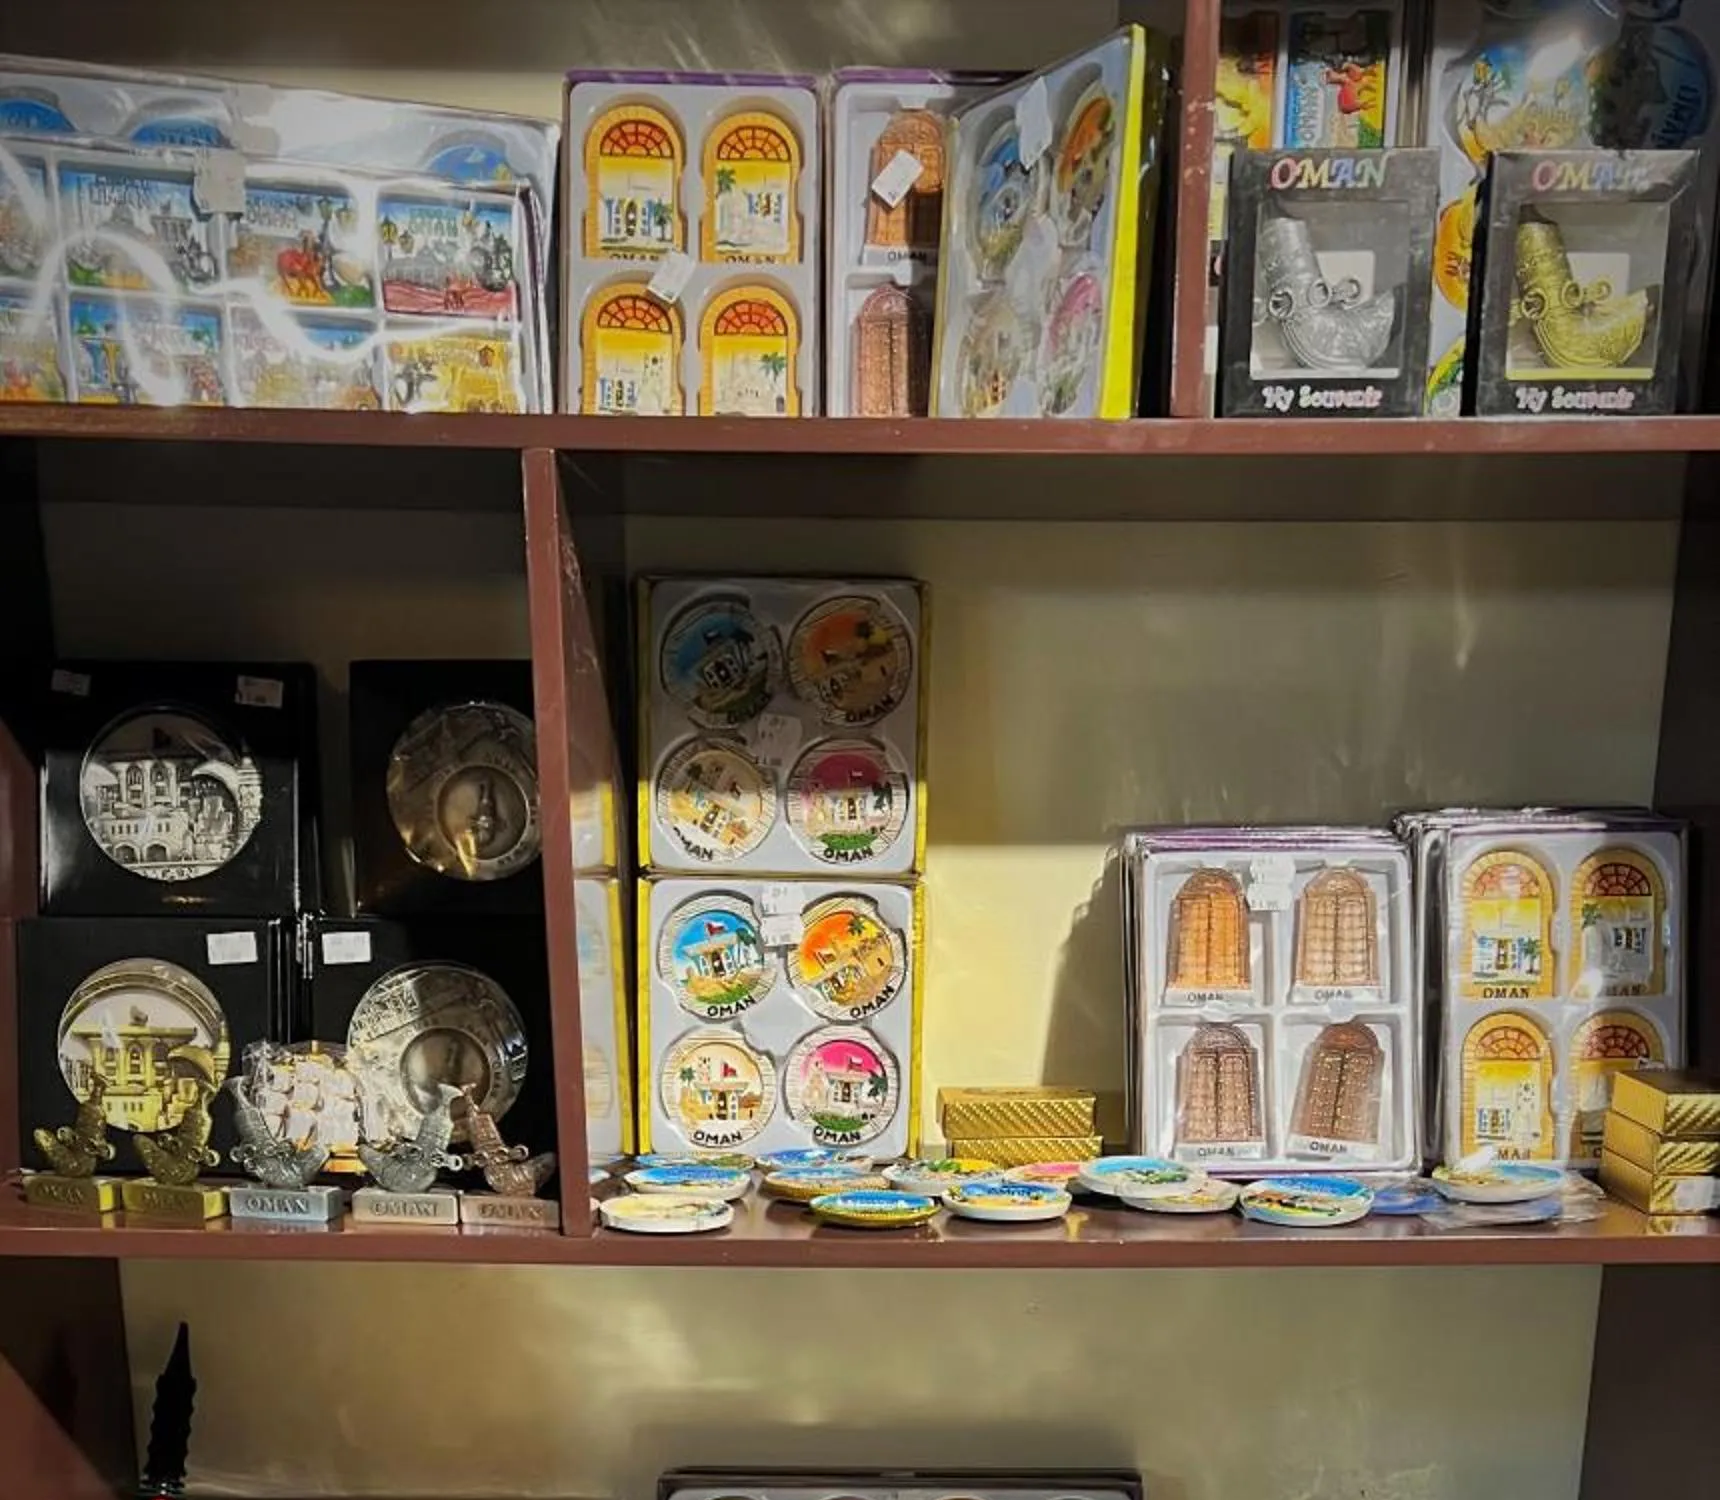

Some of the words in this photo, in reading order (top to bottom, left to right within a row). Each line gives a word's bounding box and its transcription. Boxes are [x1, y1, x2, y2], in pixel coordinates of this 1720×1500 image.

[1271, 151, 1397, 190] OMAN
[823, 847, 873, 862] OMAN
[1187, 992, 1224, 1001] OMAN
[1315, 989, 1352, 1000] OMAN
[1483, 986, 1530, 999] OMAN
[1605, 984, 1646, 997] MAN
[707, 996, 757, 1016] OMAN
[850, 986, 894, 1018] OMAN
[694, 1129, 742, 1145] OMAN
[813, 1125, 861, 1143] OMAN
[1198, 1146, 1235, 1157] OMAN
[1309, 1140, 1347, 1154] OMAN
[247, 1197, 308, 1214] OMAN
[370, 1199, 438, 1216] OMAN
